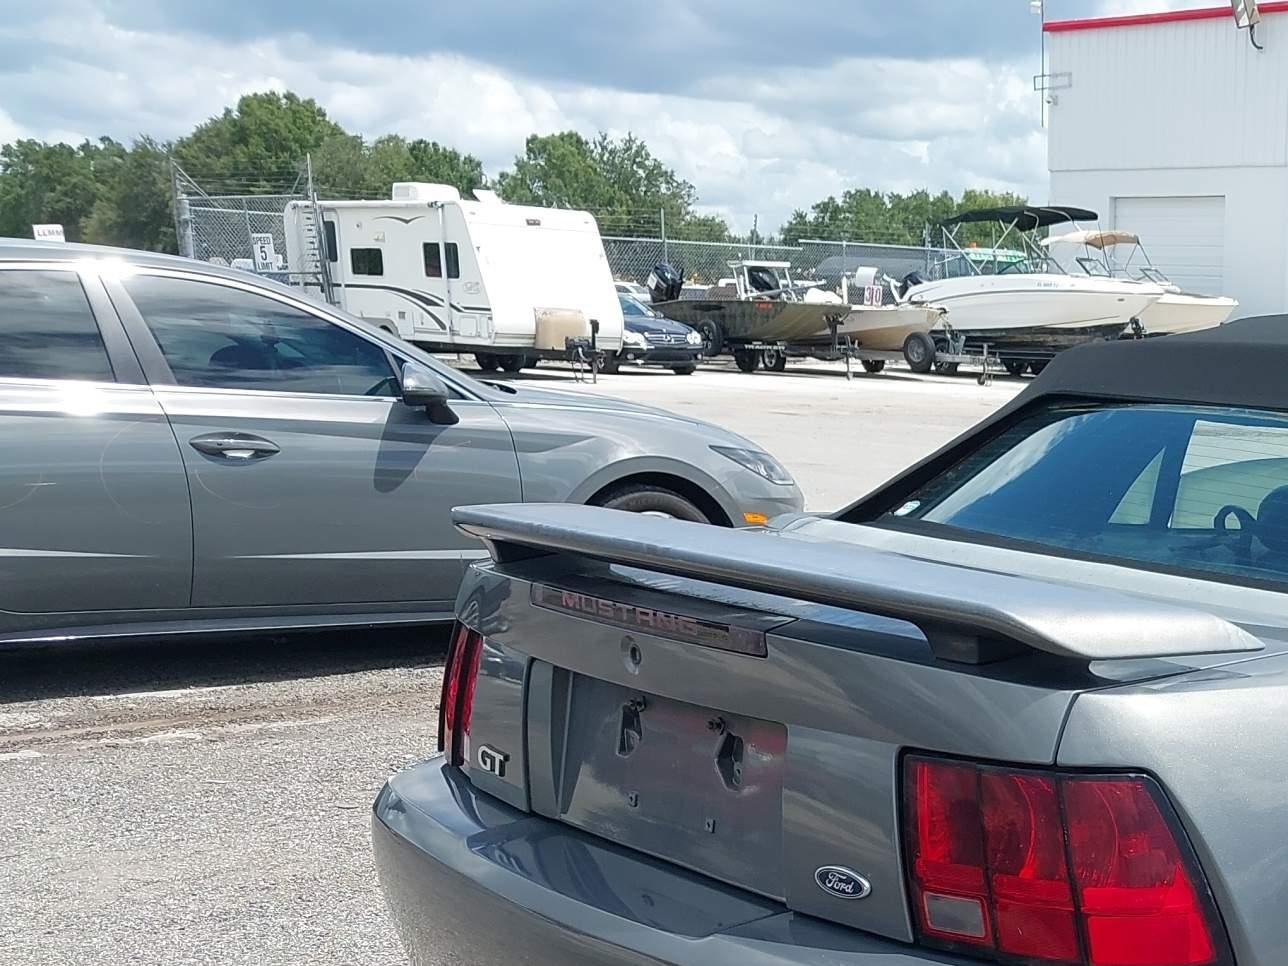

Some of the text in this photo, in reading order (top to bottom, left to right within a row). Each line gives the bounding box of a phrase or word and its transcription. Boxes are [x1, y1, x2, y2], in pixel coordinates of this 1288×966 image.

[252, 236, 271, 245] SPEED
[259, 245, 268, 261] 5
[560, 591, 698, 636] MUSTANG
[478, 745, 507, 776] GT
[825, 871, 855, 894] Ford
